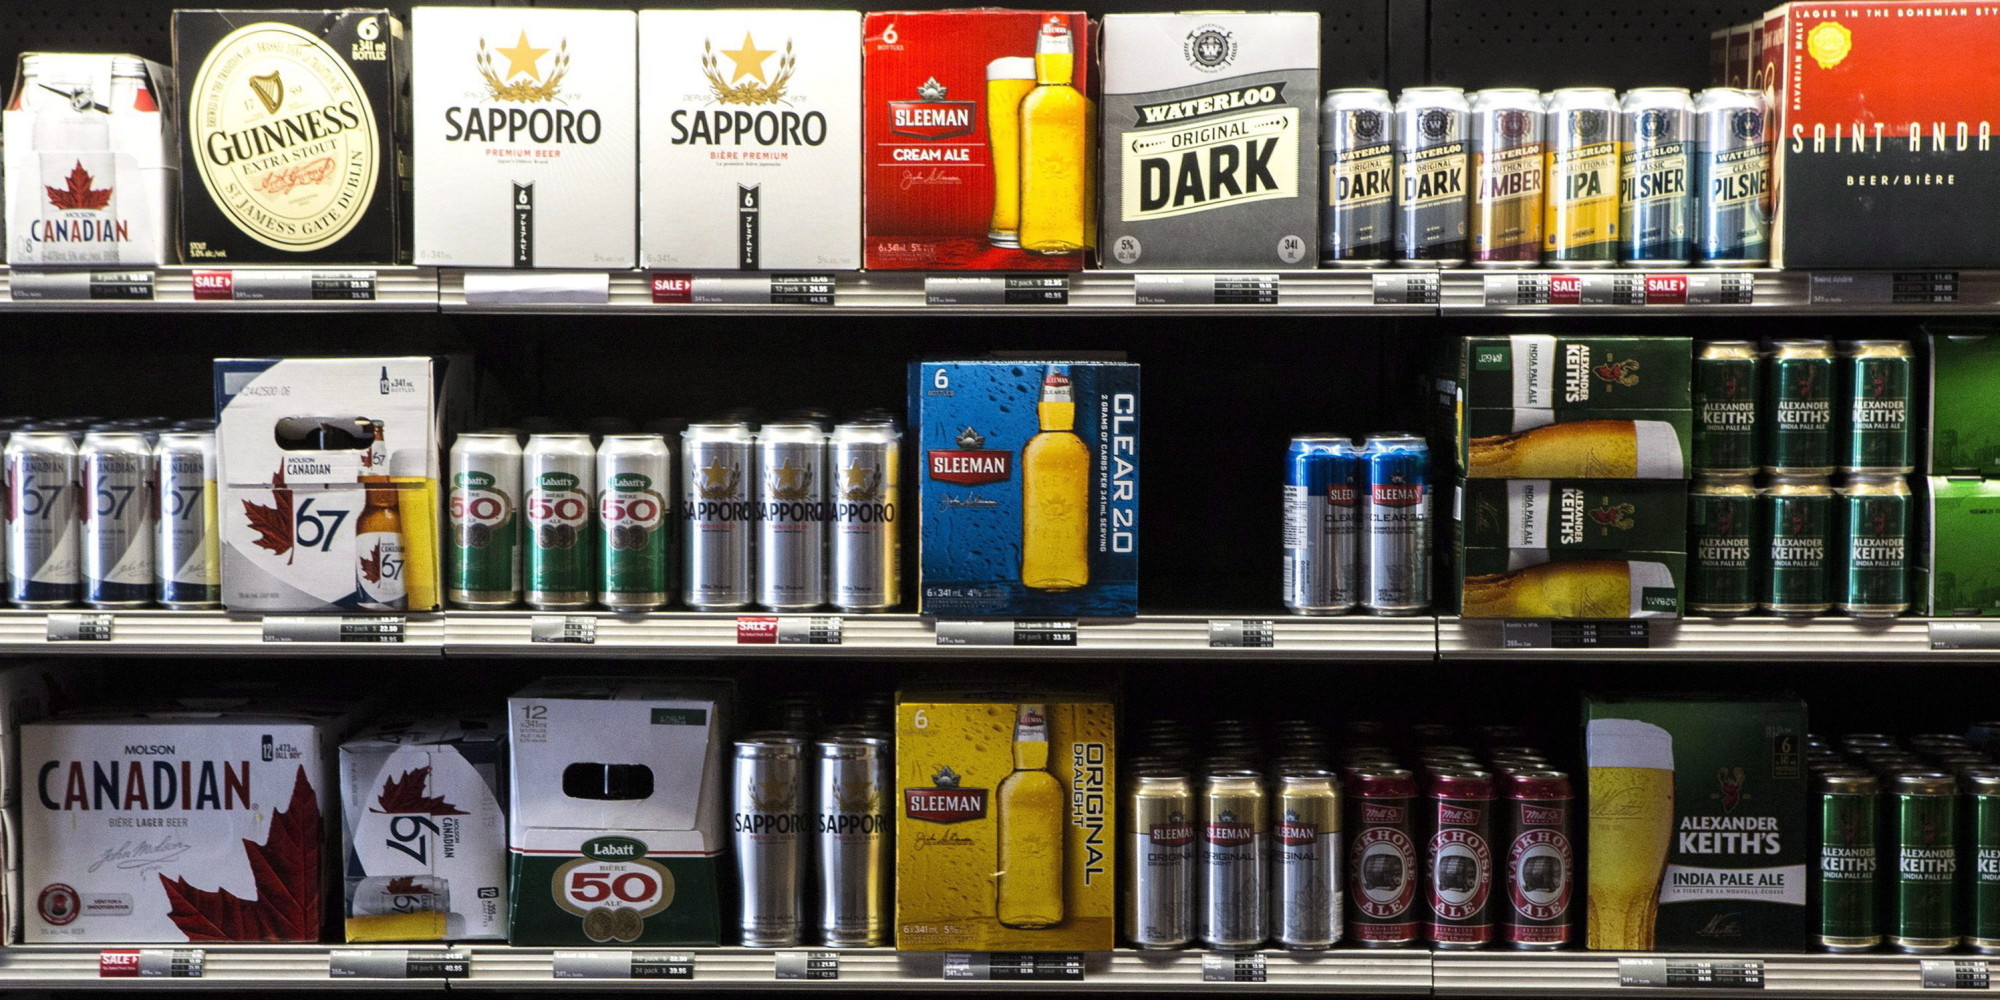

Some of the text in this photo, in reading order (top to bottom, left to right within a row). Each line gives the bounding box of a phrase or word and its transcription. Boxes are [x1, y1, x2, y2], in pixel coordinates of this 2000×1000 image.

[1795, 9, 1837, 18] LAGER
[1845, 9, 1858, 18] IN
[1866, 9, 1889, 18] THE
[1898, 8, 1968, 17] BOHEMIAN
[357, 16, 380, 41] 6
[882, 24, 898, 44] 6
[352, 51, 387, 60] BOTTLES
[1794, 22, 1803, 111] BAVARIAN MALT
[1142, 86, 1277, 124] WATERLOO
[445, 106, 601, 145] SAPPORO
[895, 108, 969, 127] SLEEMAN
[207, 100, 360, 167] GUINNESS
[671, 109, 827, 146] SAPPORO
[1171, 121, 1250, 148] ORIGINAL
[1792, 122, 1885, 153] SAINT
[242, 154, 290, 176] EXTRA
[292, 138, 338, 162] STOUT
[485, 149, 531, 157] PREMIUM
[710, 151, 788, 160] BIÈRE PREMIUM
[893, 148, 970, 162] CREAM ALE
[1339, 145, 1391, 162] WATERLOO
[1406, 144, 1462, 162] WATERLOO
[1140, 137, 1279, 212] DARK
[1349, 161, 1383, 173] ORIGINAL
[1416, 160, 1451, 173] ORIGINAL
[1733, 161, 1761, 173] CLASSIC
[1338, 168, 1391, 200] DARK
[1404, 168, 1462, 200] DARK
[1479, 169, 1541, 200] AMBER
[1566, 171, 1602, 200] IPA
[1622, 168, 1684, 204] PILSNER
[235, 198, 297, 236] JAMES'S
[302, 208, 342, 236] GATE
[338, 150, 364, 210] DUBLIN
[519, 190, 528, 204] 6
[31, 219, 130, 242] CANADIAN
[26, 238, 33, 253] 8
[1121, 240, 1133, 250] 5%
[1284, 239, 1298, 250] 341
[195, 276, 225, 288] SALE
[655, 279, 683, 291] SALE
[1553, 281, 1580, 292] SALE
[1649, 280, 1677, 291] SALE
[934, 369, 949, 389] 6
[1566, 344, 1580, 403] KEITH'S
[1580, 344, 1590, 401] ALEXANDER
[1778, 401, 1829, 410] ALEXANDER
[1777, 411, 1830, 423] KEITH'S
[1101, 429, 1108, 439] OF
[287, 464, 331, 476] CANADIAN
[934, 457, 1005, 474] SLEEMAN
[1112, 393, 1135, 553] CLEAR 2.0
[541, 476, 574, 486] Labatt's
[614, 477, 646, 488] Labatt's
[97, 475, 136, 520] 67
[451, 497, 502, 520] 50
[529, 498, 585, 520] 50
[601, 499, 658, 522] 50
[1525, 485, 1534, 545] INDIA PALE ALE
[1561, 488, 1575, 544] KEITH'S
[1574, 488, 1584, 543] ALEXANDER
[296, 498, 350, 553] 67
[1853, 538, 1904, 547] ALEXANDER
[1852, 547, 1904, 560] KEITH'S
[382, 554, 405, 580] 67
[739, 621, 767, 631] SALE
[521, 705, 547, 719] 12
[914, 709, 928, 728] 6
[125, 745, 175, 755] MOLSON
[263, 744, 273, 759] 12
[38, 760, 251, 811] CANADIAN
[1072, 743, 1084, 827] DRAUGHT
[911, 796, 981, 812] SLEEMAN
[109, 816, 188, 827] BIÈRE LAGER BEER
[1085, 743, 1104, 886] ORIGINAL
[1680, 817, 1778, 830] ALEXANDER
[386, 815, 440, 866] 67
[442, 817, 455, 858] CANADIAN
[1206, 828, 1250, 840] SLEEMAN
[593, 844, 634, 855] Labatt
[1679, 832, 1781, 854] KEITH'S
[1508, 831, 1572, 883] TANKHOUSE
[1821, 848, 1876, 857] ALEXANDER
[599, 864, 627, 872] BIÈRE
[1821, 857, 1876, 871] KEITH'S
[1673, 873, 1785, 886] INDIA PALE ALE
[1824, 871, 1873, 879] INDIA PALE ALE
[481, 888, 497, 898] 12
[570, 872, 658, 903] 50
[1363, 900, 1403, 917] ALE
[1435, 902, 1474, 917] ALE
[1523, 902, 1561, 917] ALE
[102, 955, 130, 966] SALE
[643, 967, 658, 975] pack
